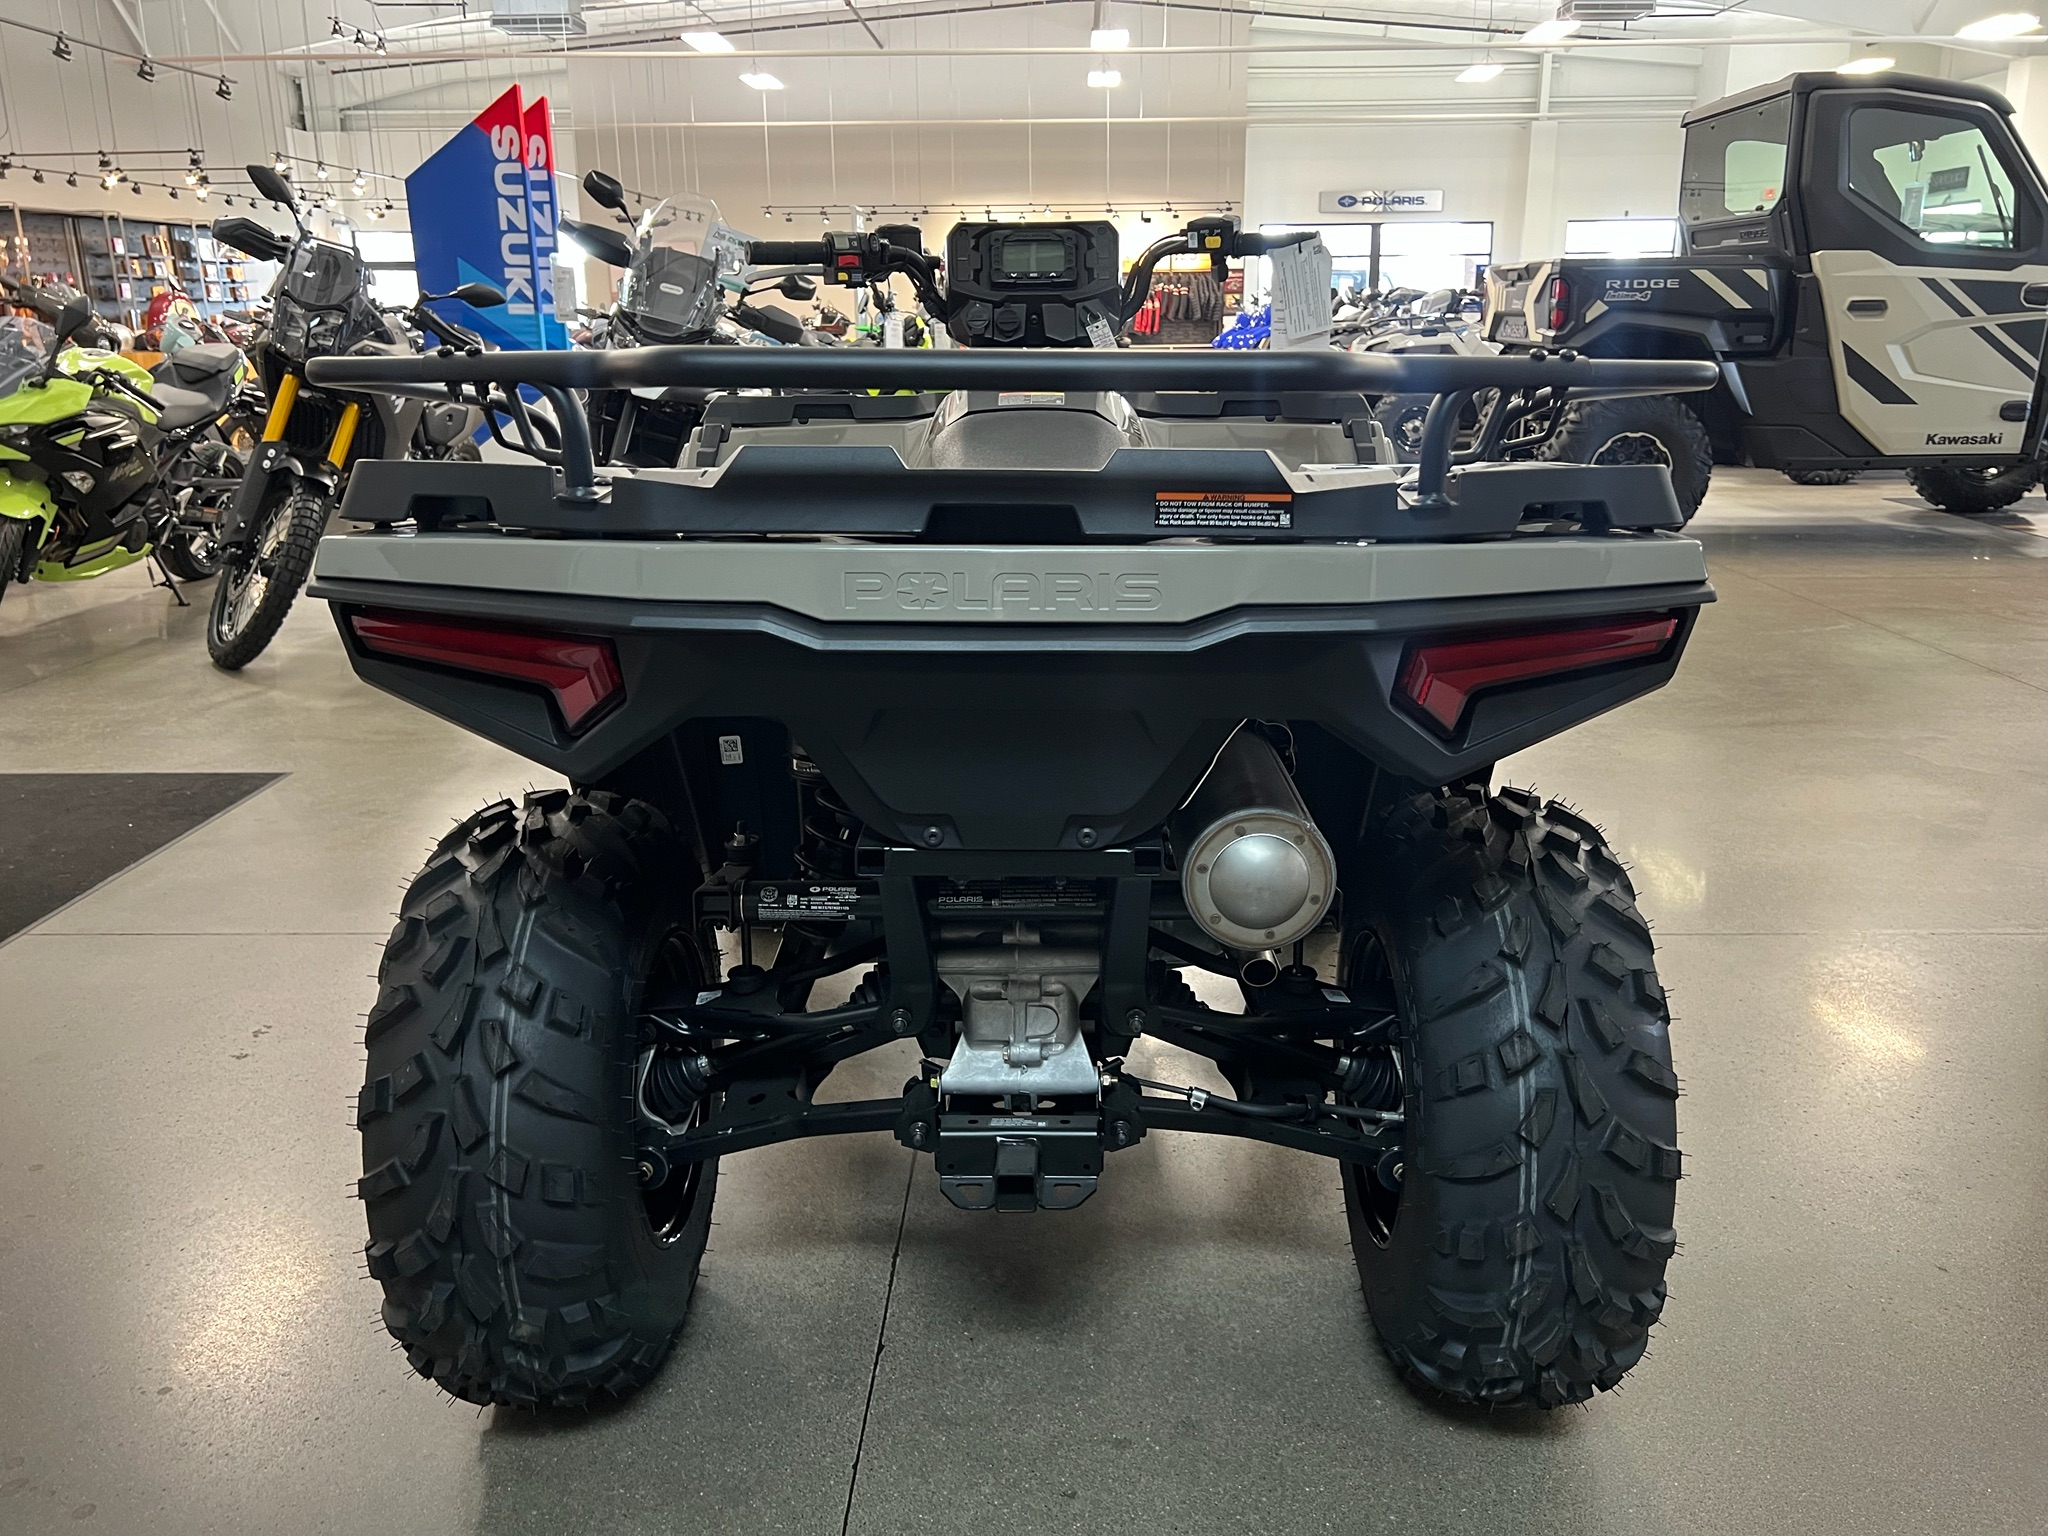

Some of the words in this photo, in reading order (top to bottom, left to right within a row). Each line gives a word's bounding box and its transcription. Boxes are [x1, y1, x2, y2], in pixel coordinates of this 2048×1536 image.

[1361, 196, 1425, 206] POLARIS
[491, 124, 535, 315] SUZUKI
[1606, 279, 1680, 289] RIDGE
[1925, 432, 2004, 445] Kawasaki
[1210, 494, 1246, 502] WARNING
[844, 571, 1162, 611] POLARIS
